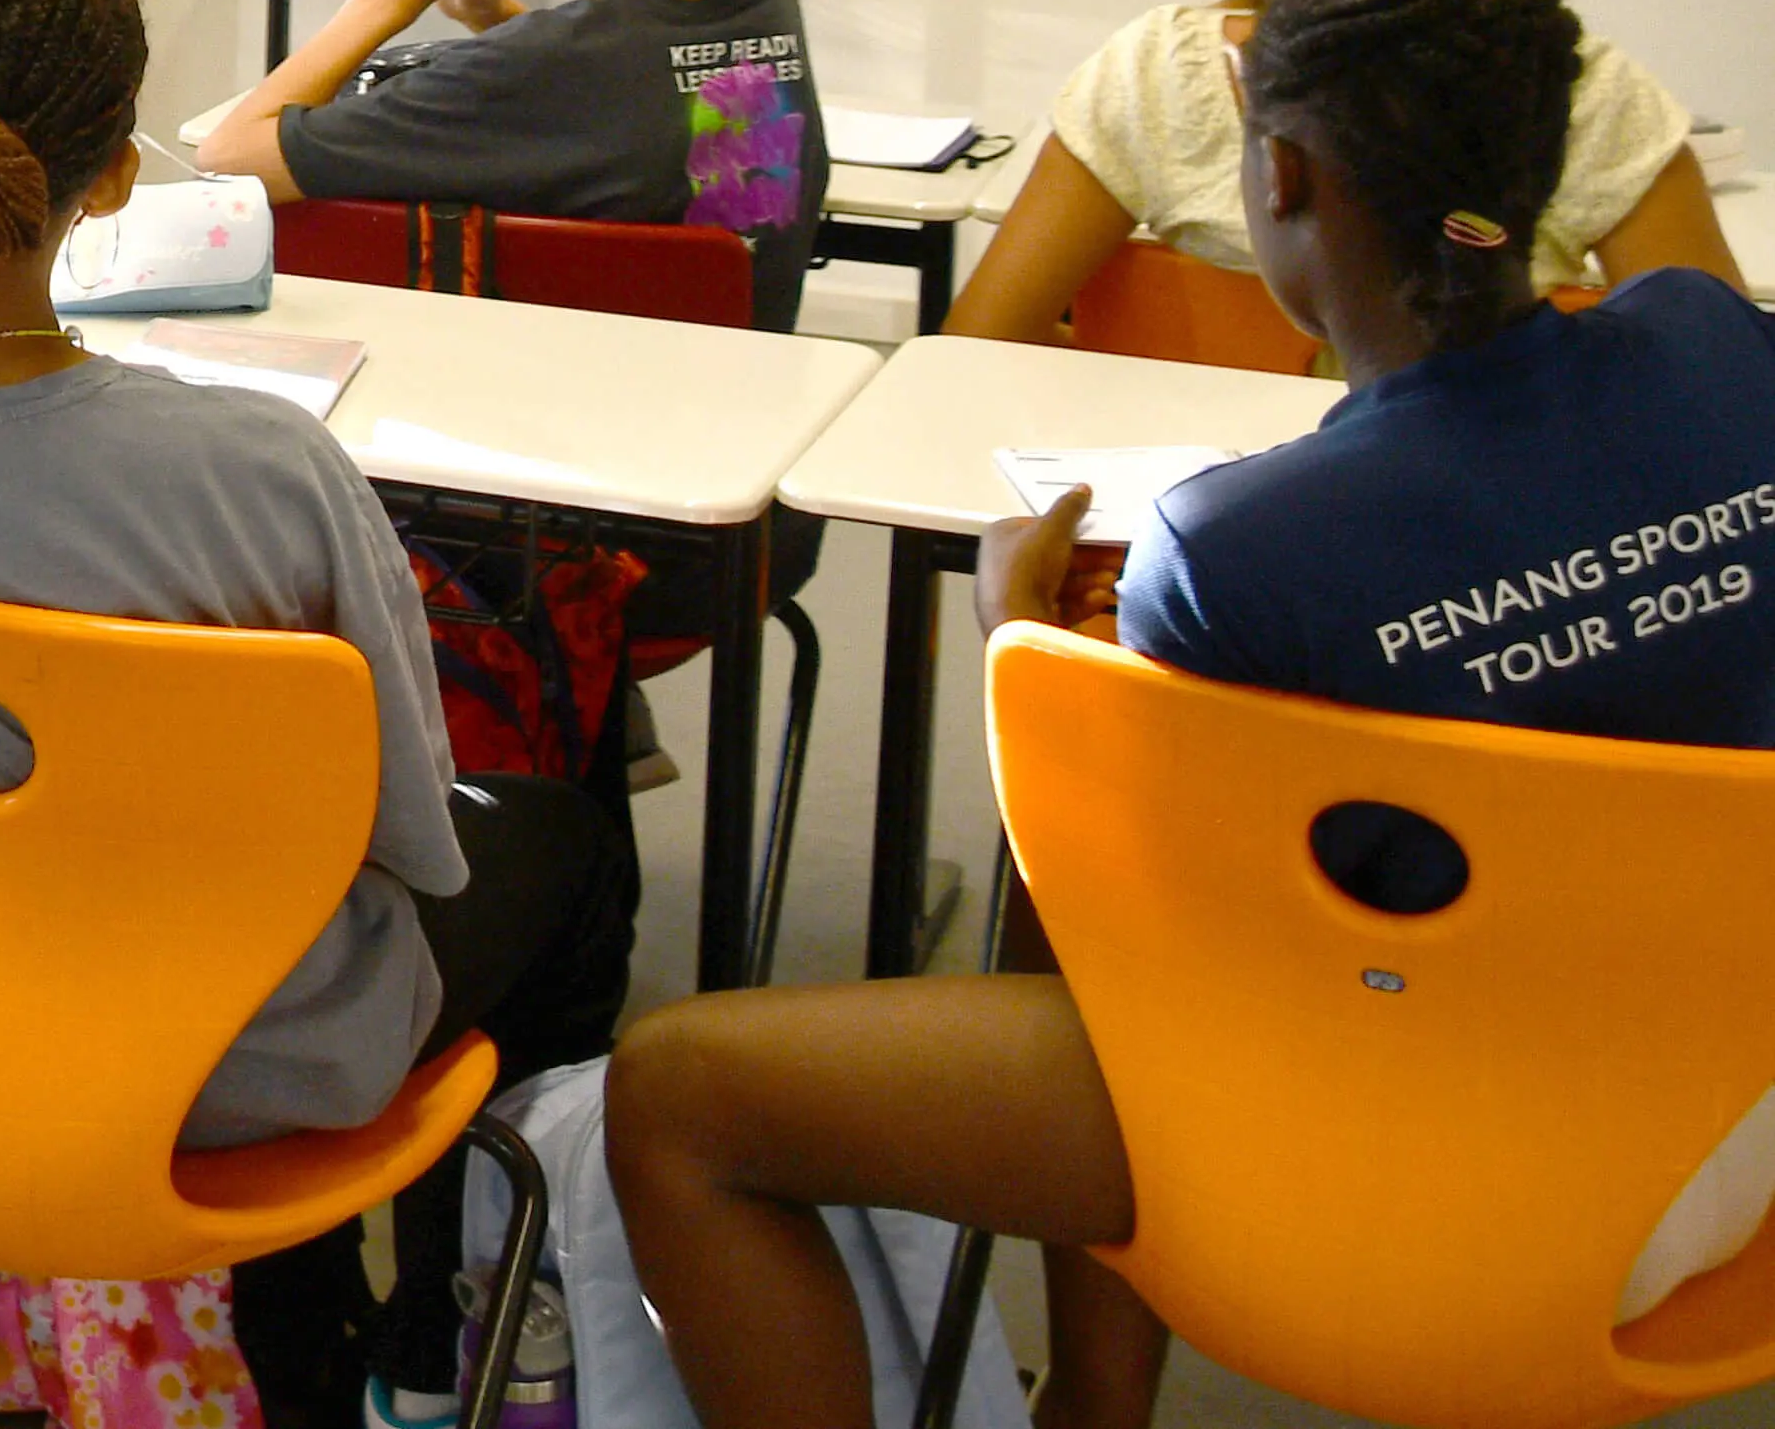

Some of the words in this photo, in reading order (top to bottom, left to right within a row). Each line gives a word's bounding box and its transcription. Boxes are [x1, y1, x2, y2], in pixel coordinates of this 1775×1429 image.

[668, 42, 728, 68] KEEP
[730, 34, 799, 60] READY
[1375, 548, 1606, 664] PENANG
[1608, 483, 1775, 576] SPORTS
[1463, 615, 1618, 694] TOUR
[1627, 563, 1754, 639] 2019
